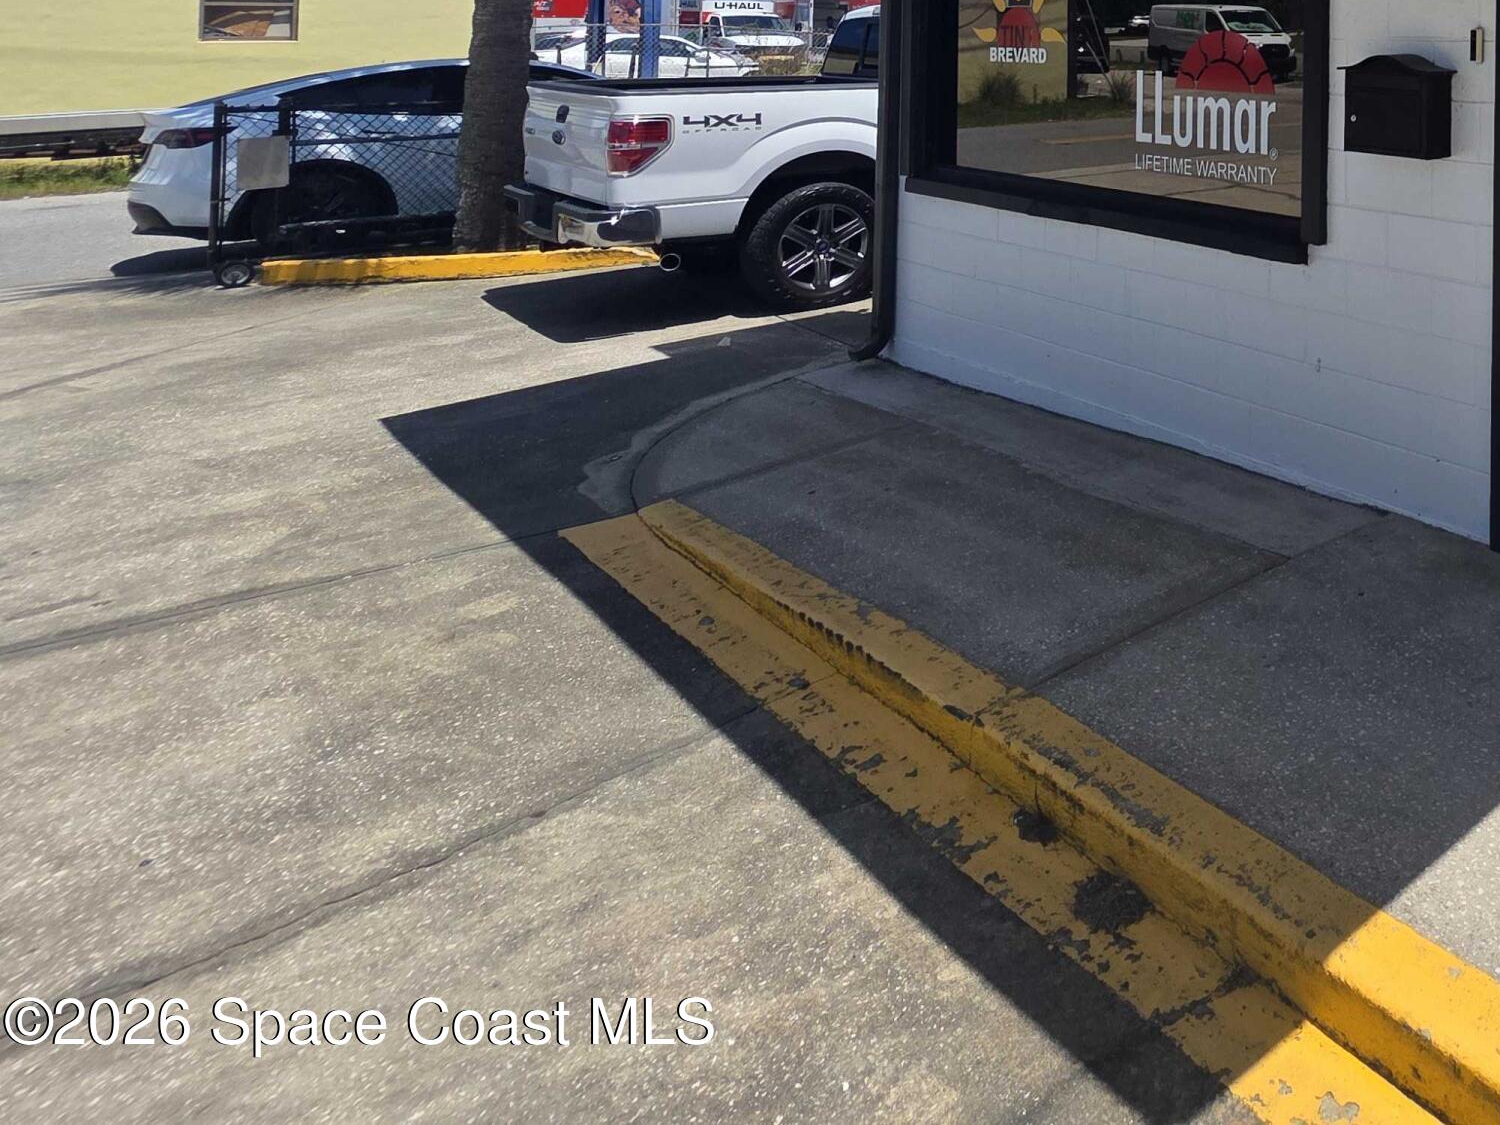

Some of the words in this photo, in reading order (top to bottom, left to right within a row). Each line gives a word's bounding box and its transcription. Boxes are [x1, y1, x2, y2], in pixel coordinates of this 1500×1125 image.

[714, 1, 764, 10] U-HAUL
[989, 47, 1047, 64] BREVARD
[1135, 153, 1192, 176] LIFETIME
[1196, 159, 1277, 186] WARRANTY
